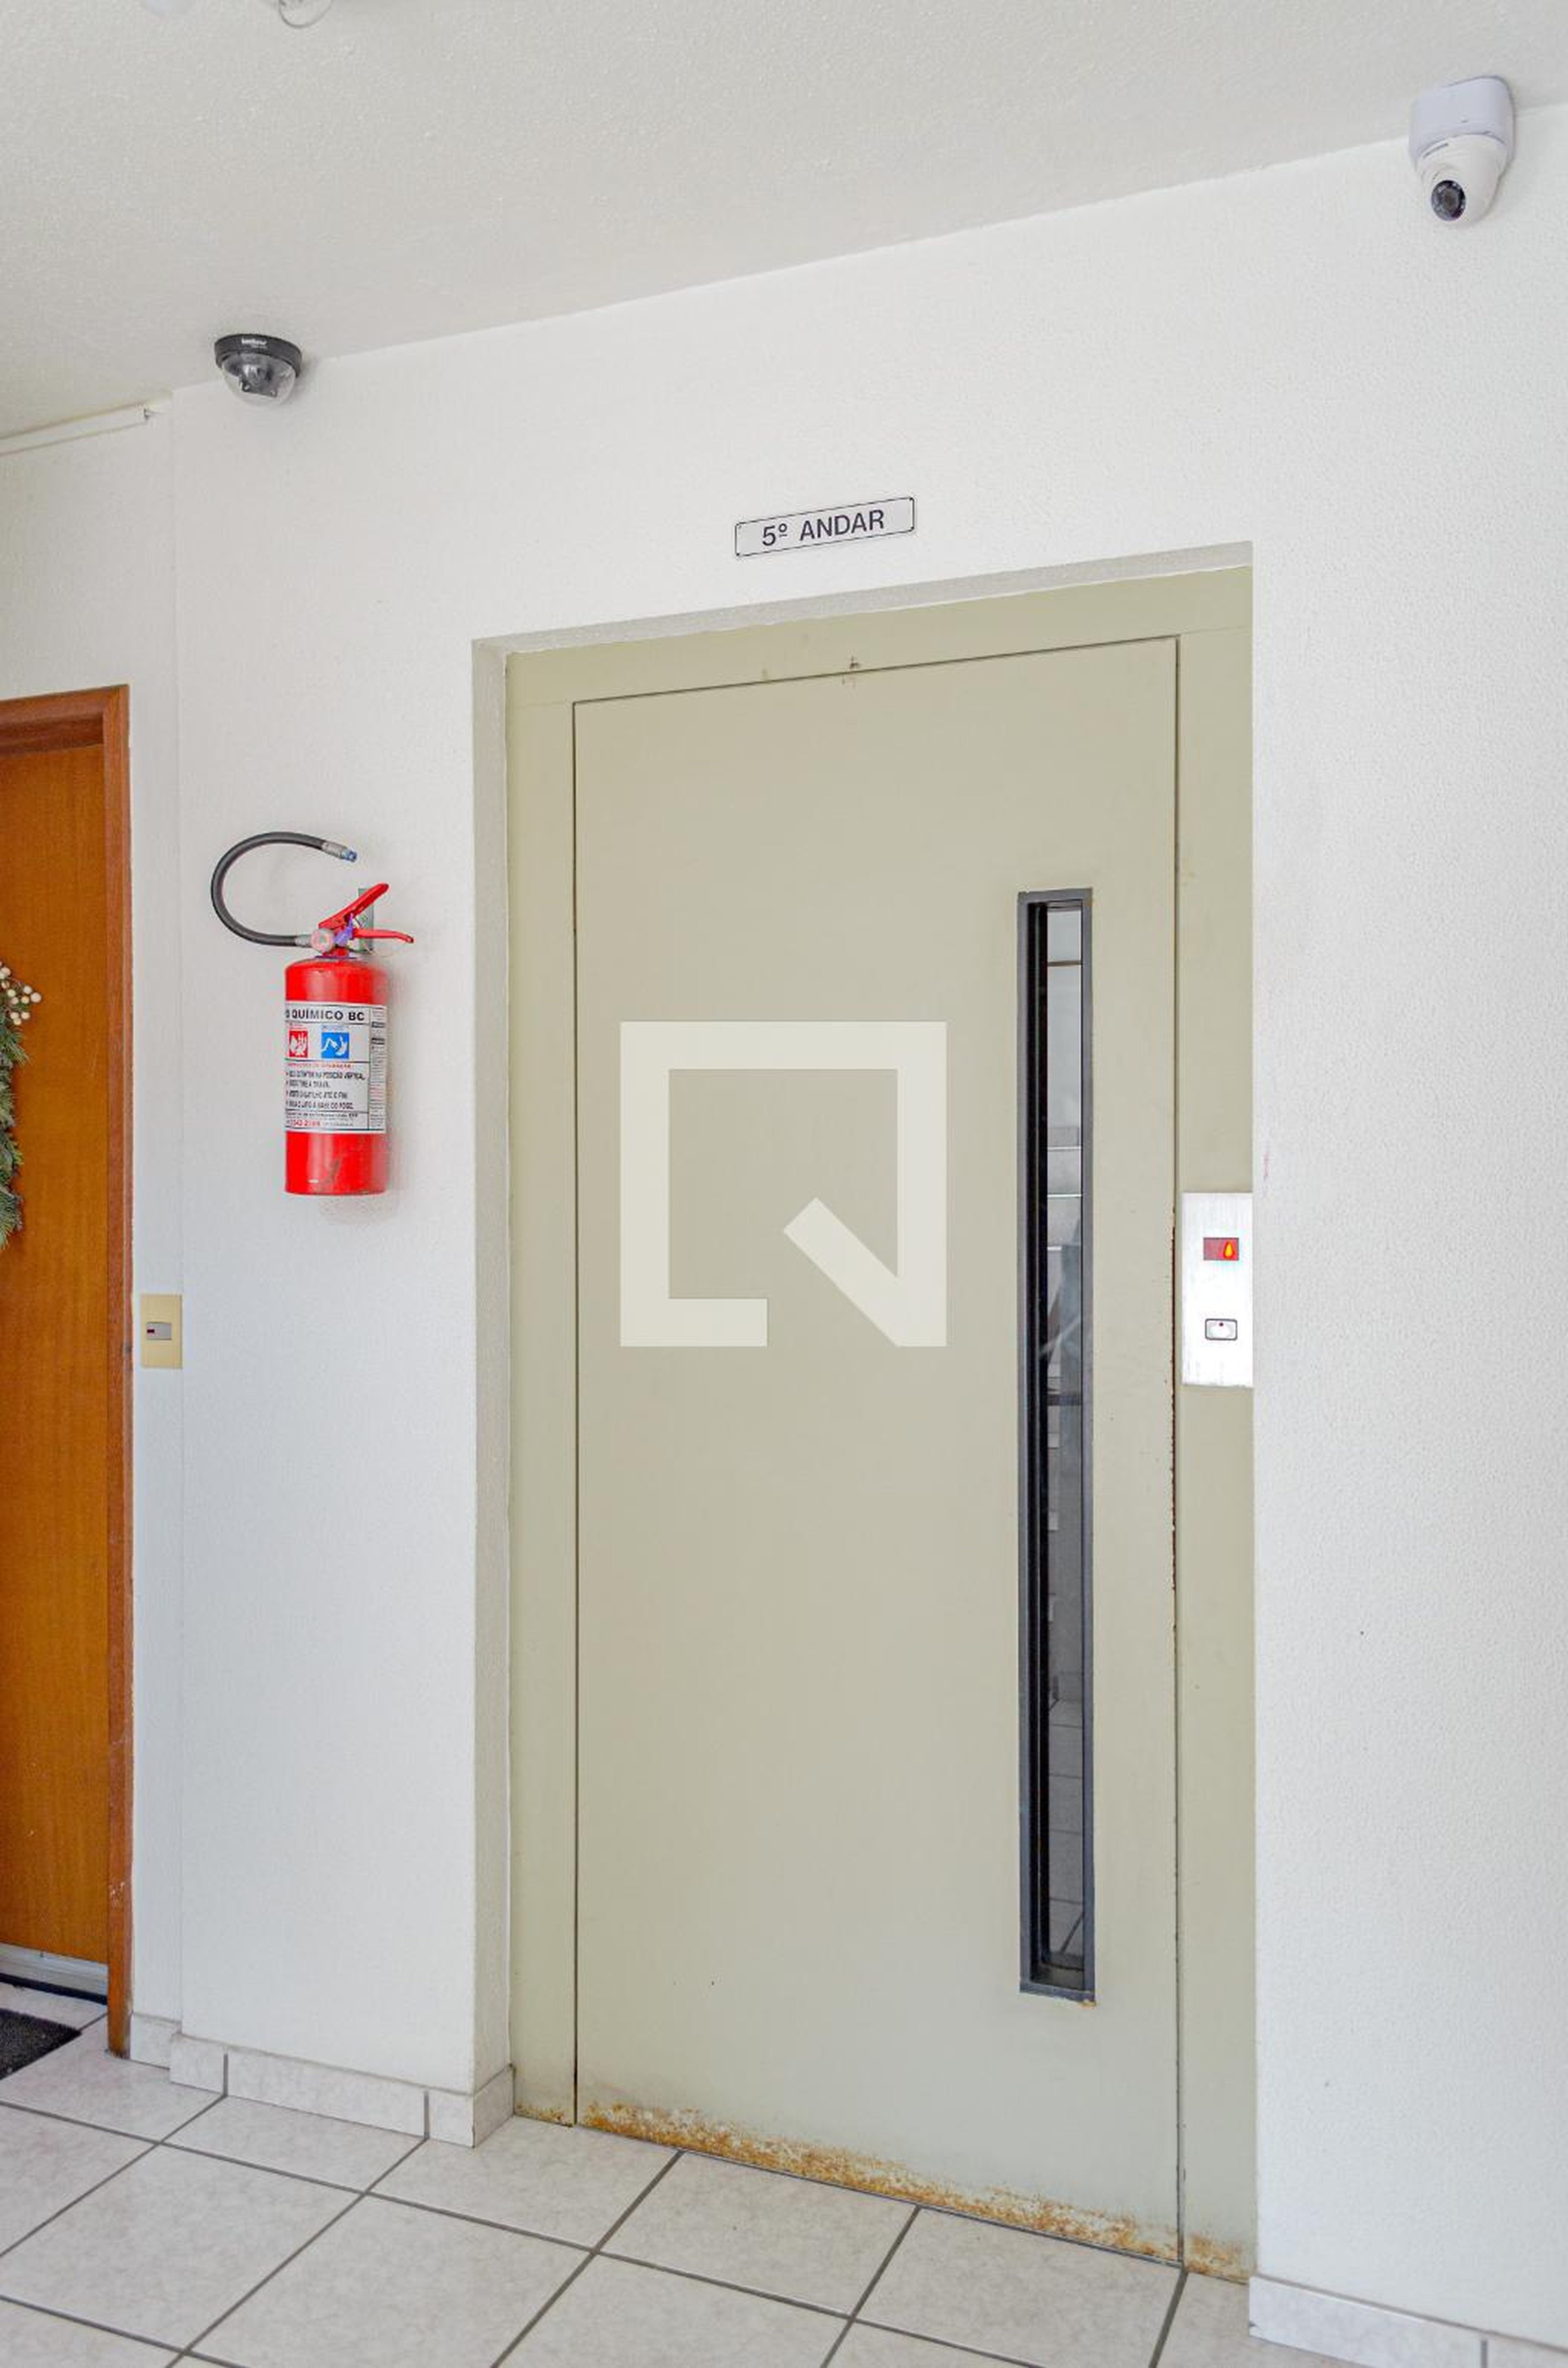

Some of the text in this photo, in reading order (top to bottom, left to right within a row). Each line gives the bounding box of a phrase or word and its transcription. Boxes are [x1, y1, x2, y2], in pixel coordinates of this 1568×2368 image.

[762, 509, 884, 546] 5º ANDAR
[348, 1012, 365, 1021] BC
